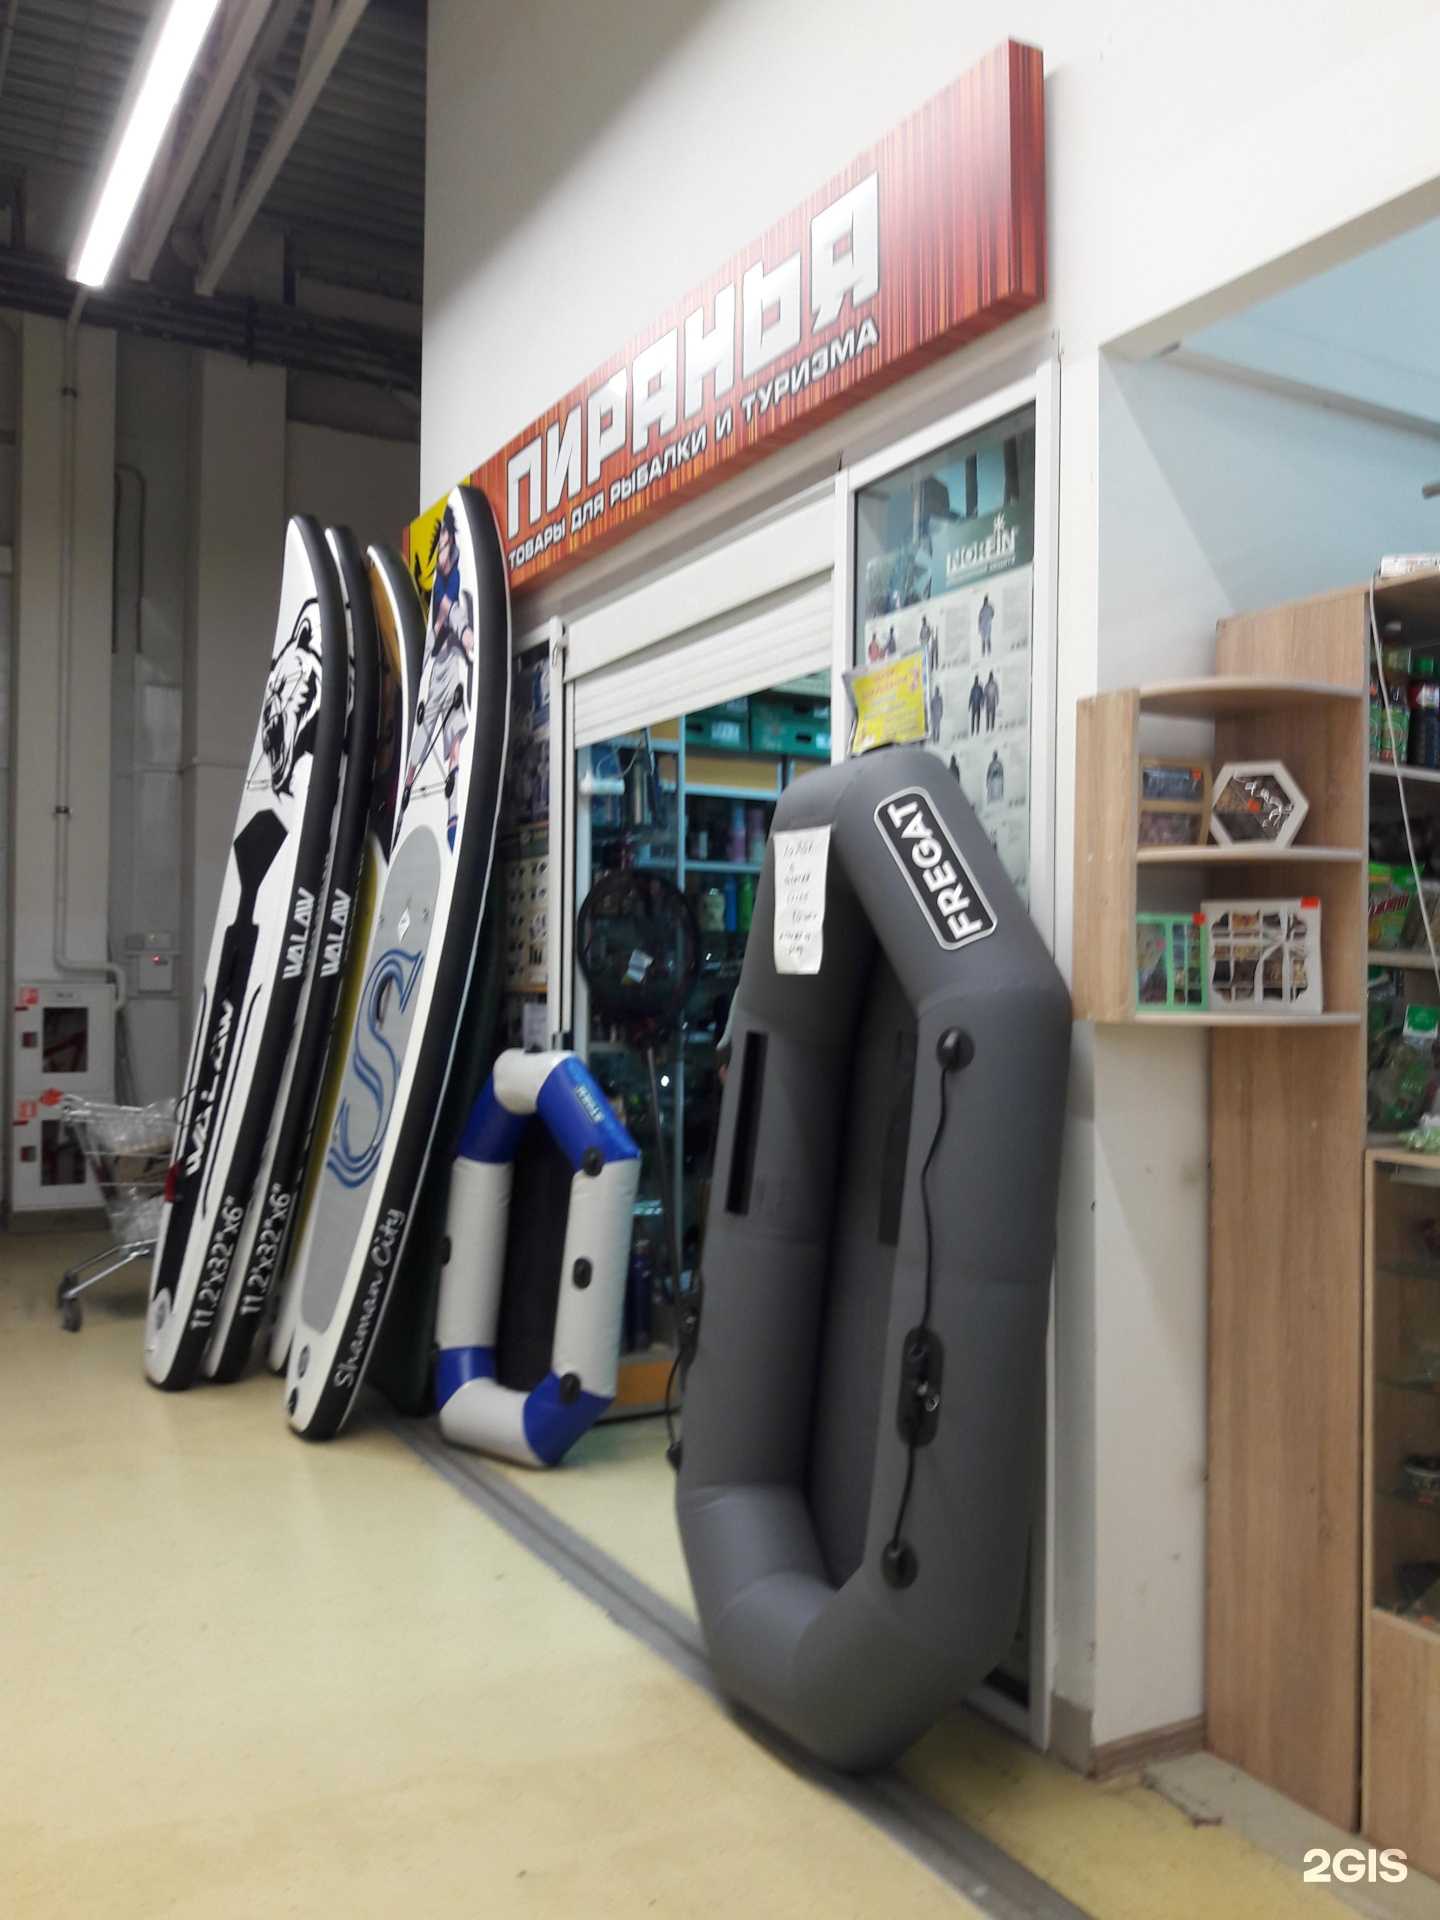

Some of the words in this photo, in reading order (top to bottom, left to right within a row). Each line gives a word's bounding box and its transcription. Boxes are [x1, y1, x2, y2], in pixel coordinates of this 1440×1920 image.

[507, 171, 878, 540] ПИРАНЬЯ
[508, 517, 566, 569] ТОВАРЫ
[571, 490, 604, 534] ДЛЯ
[609, 423, 707, 507] РЫБАЛКИ
[715, 408, 732, 441] И
[742, 317, 879, 423] ТУРИЗМА
[283, 887, 315, 980] WALAW
[320, 888, 350, 978] WALAW
[887, 801, 983, 940] FREGAT
[334, 1270, 381, 1388] Shaman
[371, 1208, 404, 1267] City
